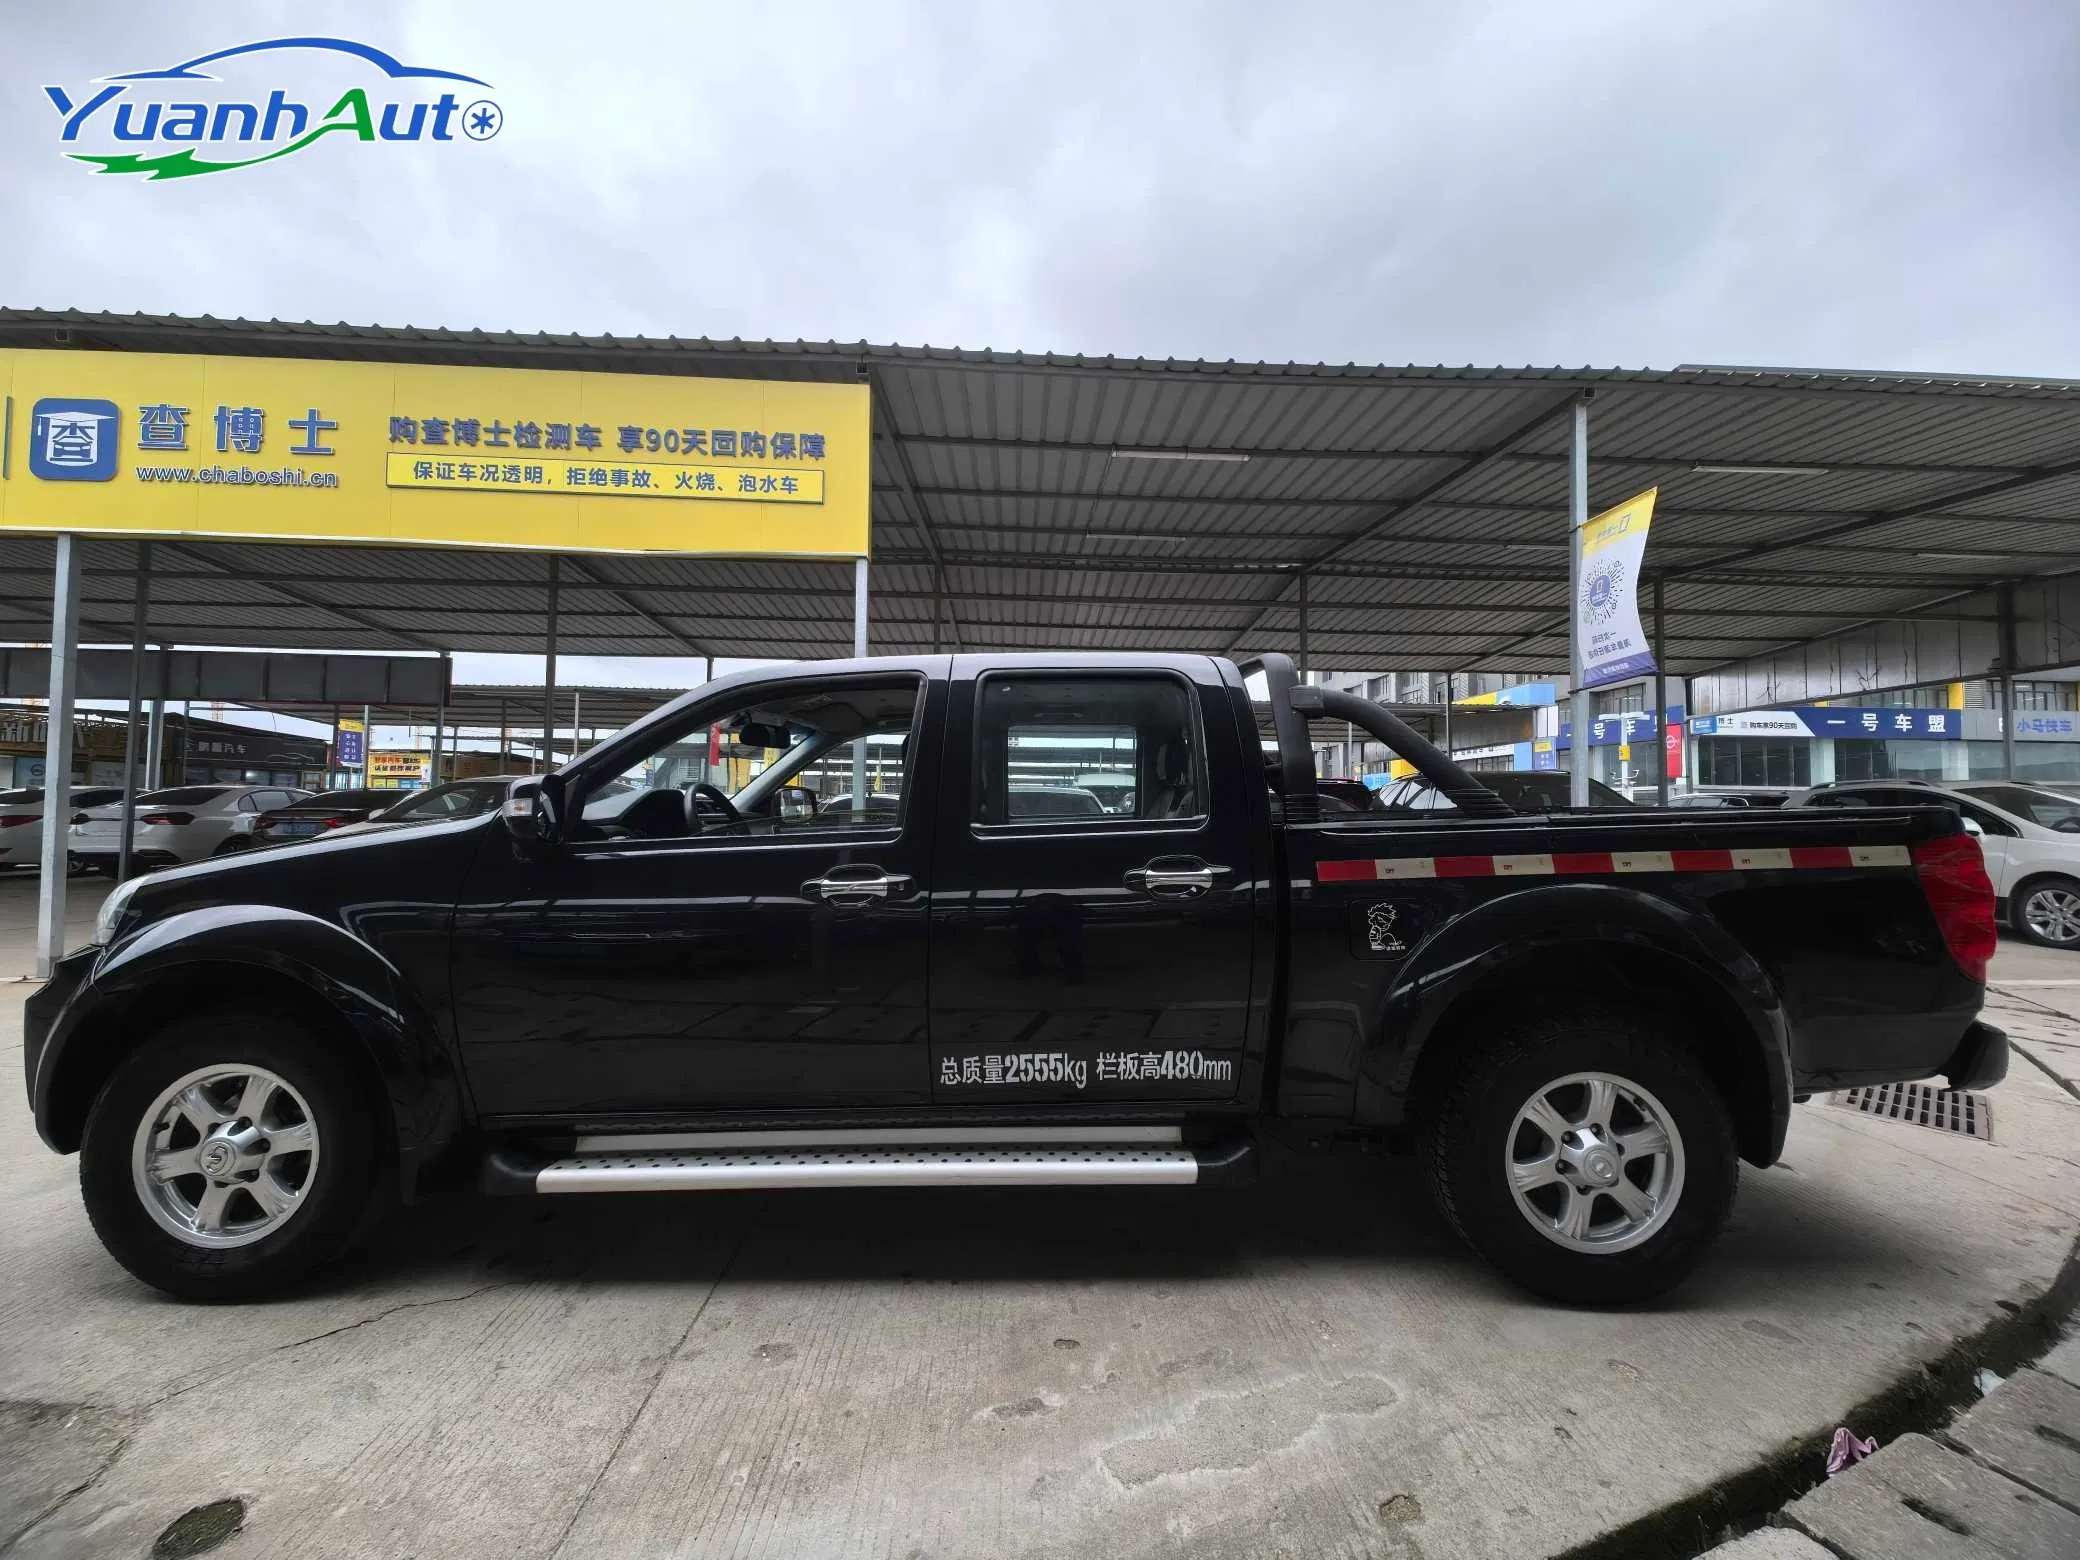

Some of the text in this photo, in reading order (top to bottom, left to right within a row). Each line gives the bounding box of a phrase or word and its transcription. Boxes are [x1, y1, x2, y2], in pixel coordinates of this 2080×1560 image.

[137, 404, 338, 455] 查博士
[389, 415, 826, 461] 购查博士检测车 享90天回购保障
[135, 465, 338, 487] www.chaboshi.cn
[1827, 713, 1946, 733] 一号车盟
[940, 1050, 1232, 1089] 总质量2555kg 栏板高480mm
